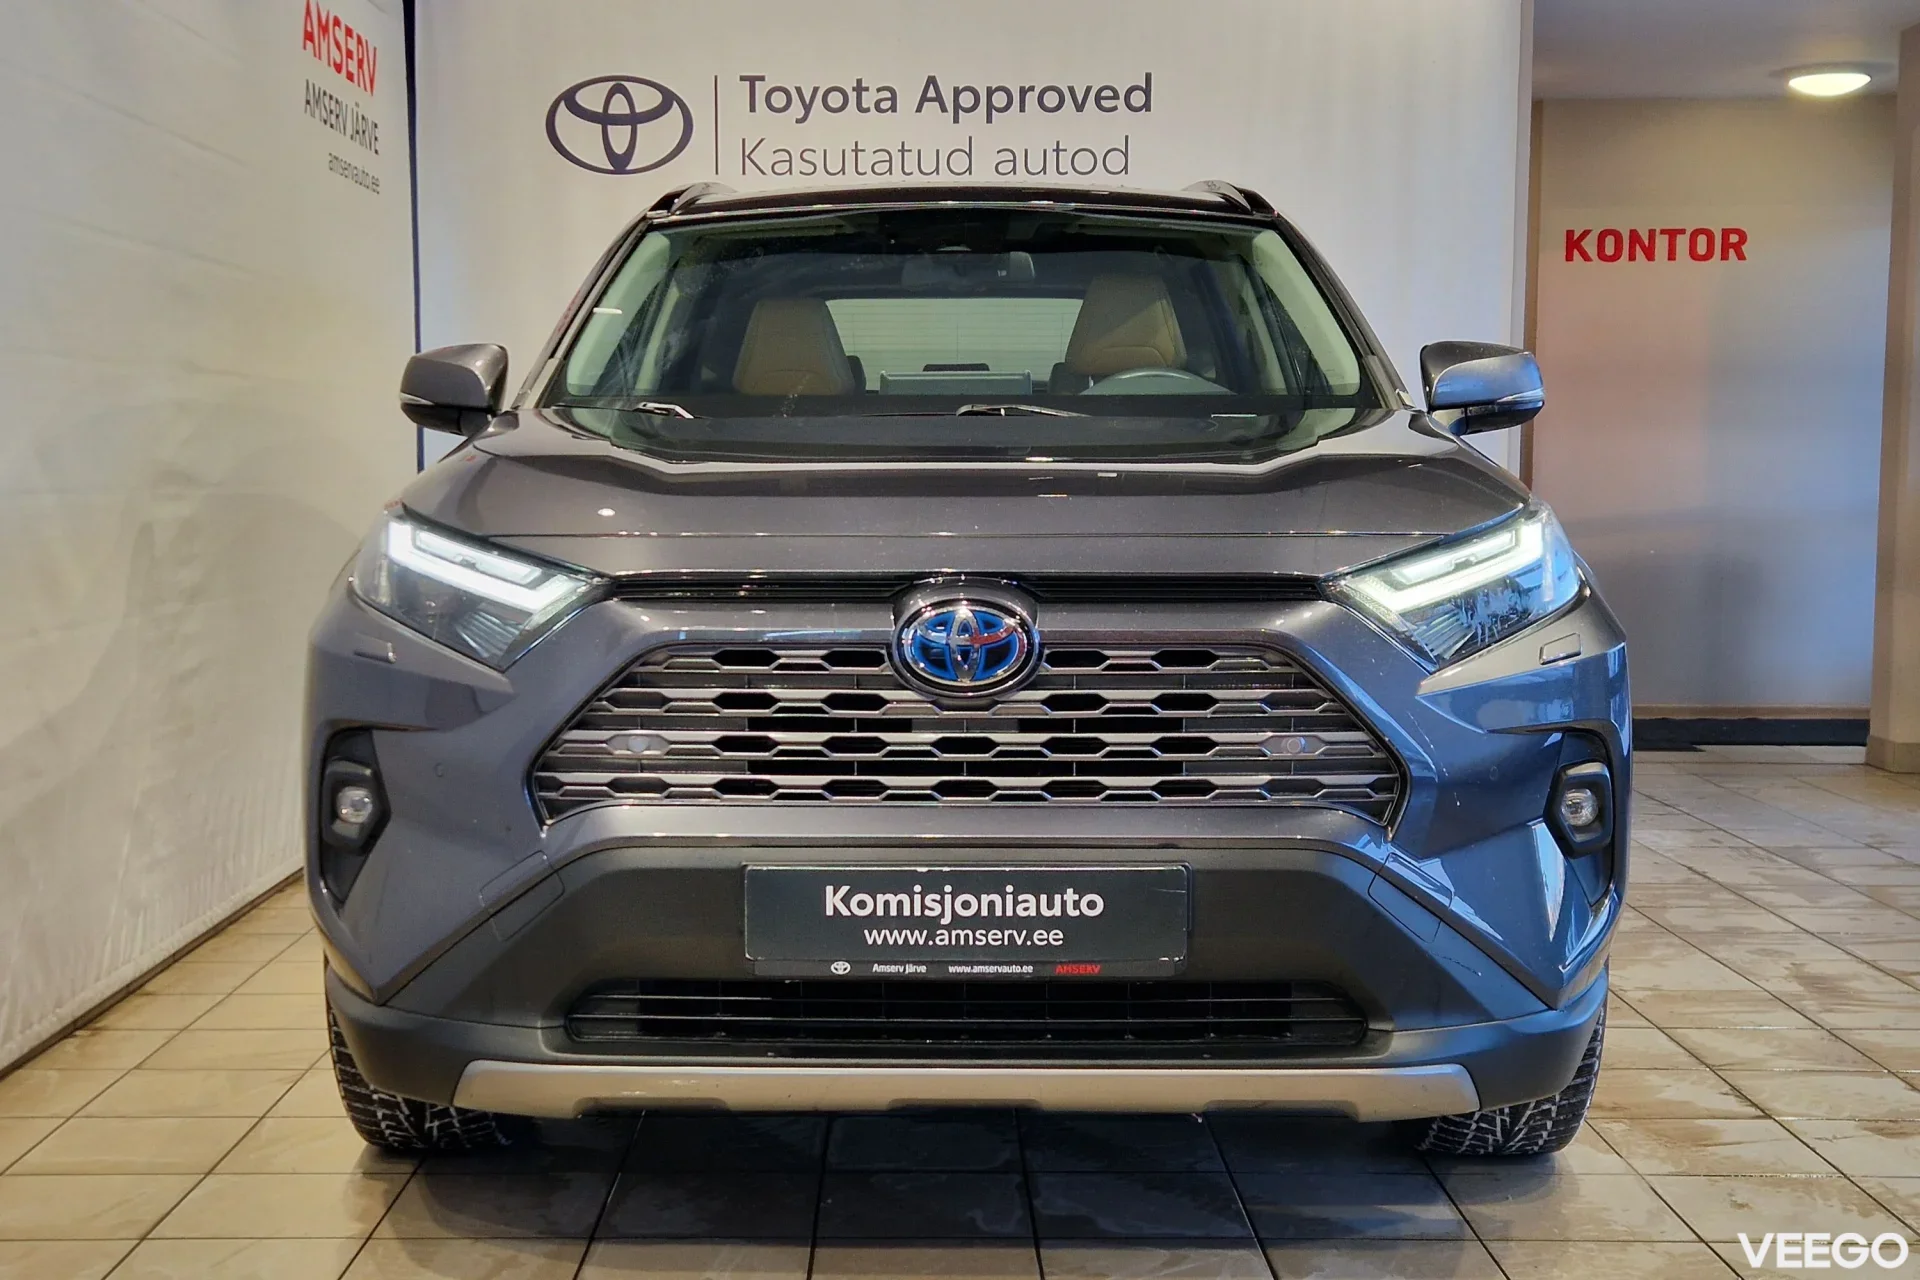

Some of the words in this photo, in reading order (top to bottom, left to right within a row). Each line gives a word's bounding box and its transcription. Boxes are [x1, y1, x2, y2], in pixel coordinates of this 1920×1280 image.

[302, 0, 378, 97] AMSERV
[304, 78, 349, 137] AMSERV
[350, 101, 380, 156] JÄRVE
[739, 73, 899, 124] Toyota
[914, 71, 1154, 124] Approved
[328, 151, 381, 195] amservauto.ee
[740, 135, 974, 177] Kasutatud
[994, 134, 1131, 177] autod
[1565, 227, 1749, 263] KONTOR
[824, 884, 1105, 925] Komisjoniauto
[863, 926, 1065, 947] www.amserv.ee
[872, 963, 904, 974] Amserv
[905, 963, 927, 975] Järve
[948, 963, 1034, 974] www.amservauto.ee
[1055, 964, 1101, 975] AMSERV
